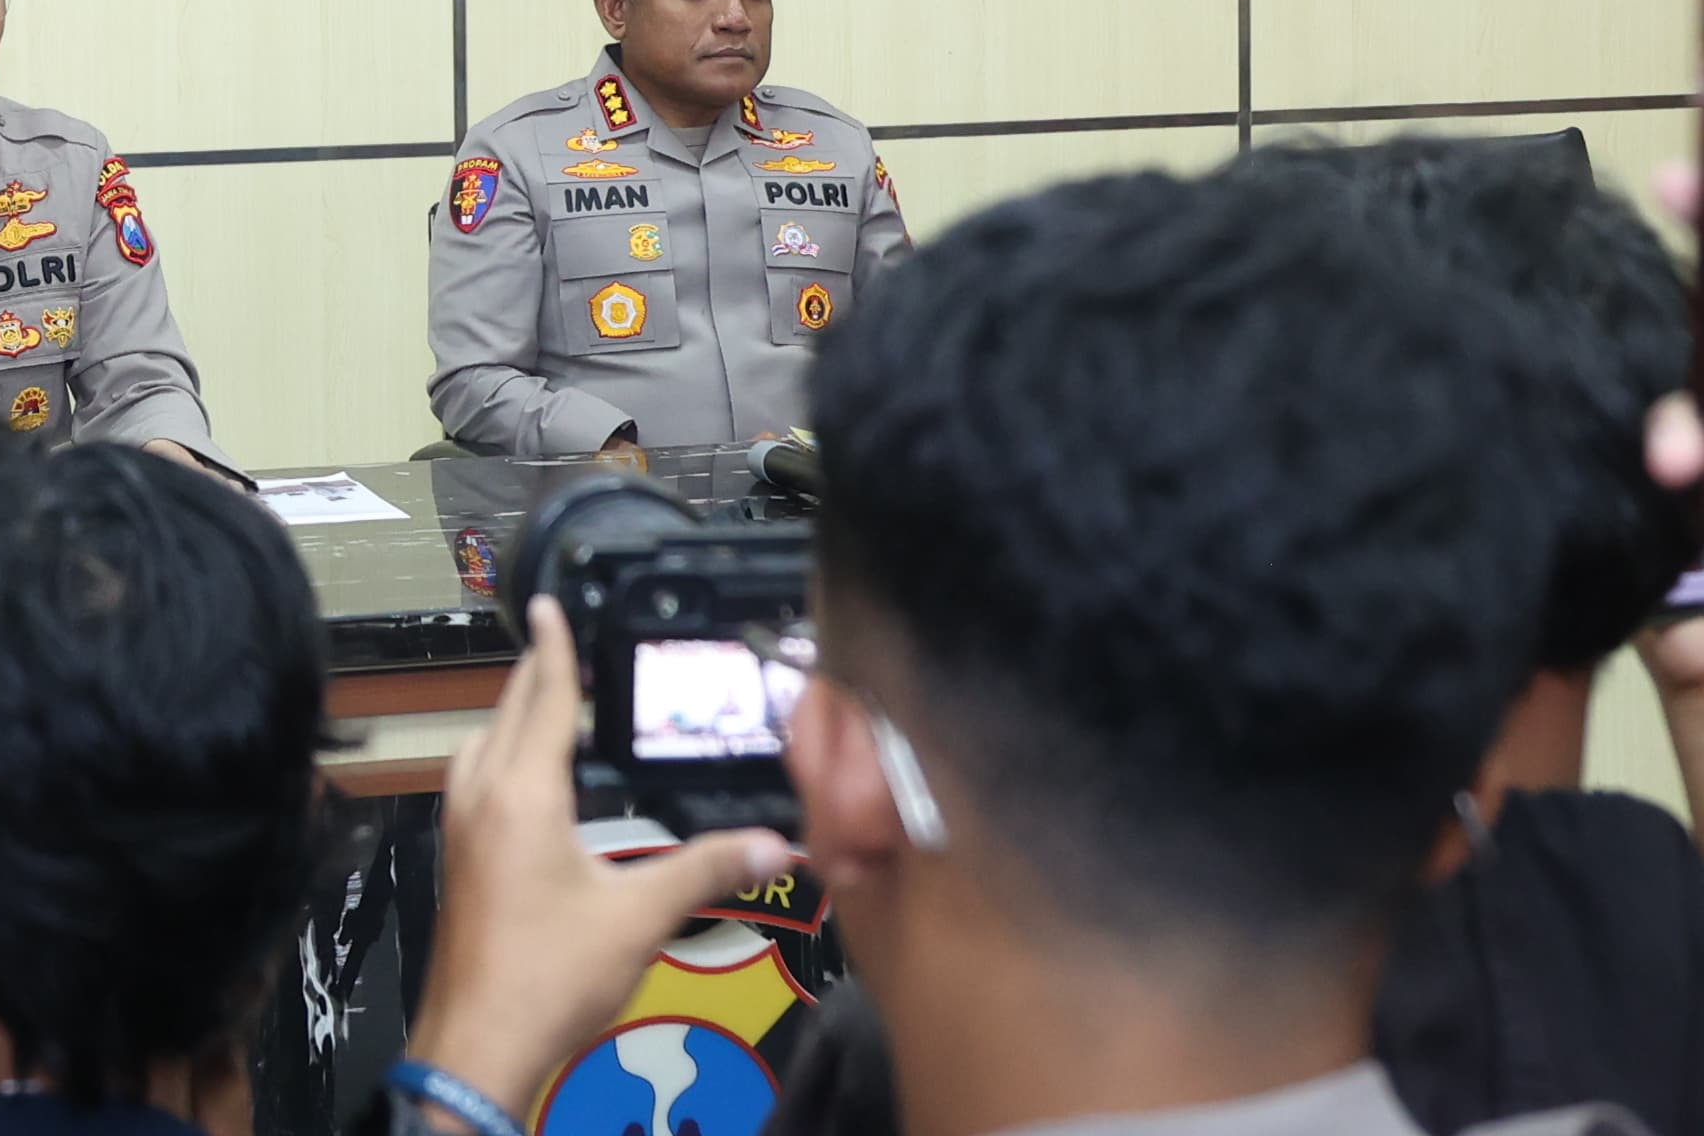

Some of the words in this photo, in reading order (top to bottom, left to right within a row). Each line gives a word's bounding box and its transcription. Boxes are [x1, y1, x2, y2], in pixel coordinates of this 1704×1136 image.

[98, 160, 125, 186] OLDA
[457, 159, 499, 173] PROPAM
[564, 184, 649, 213] IMAN
[764, 181, 849, 208] POLRI
